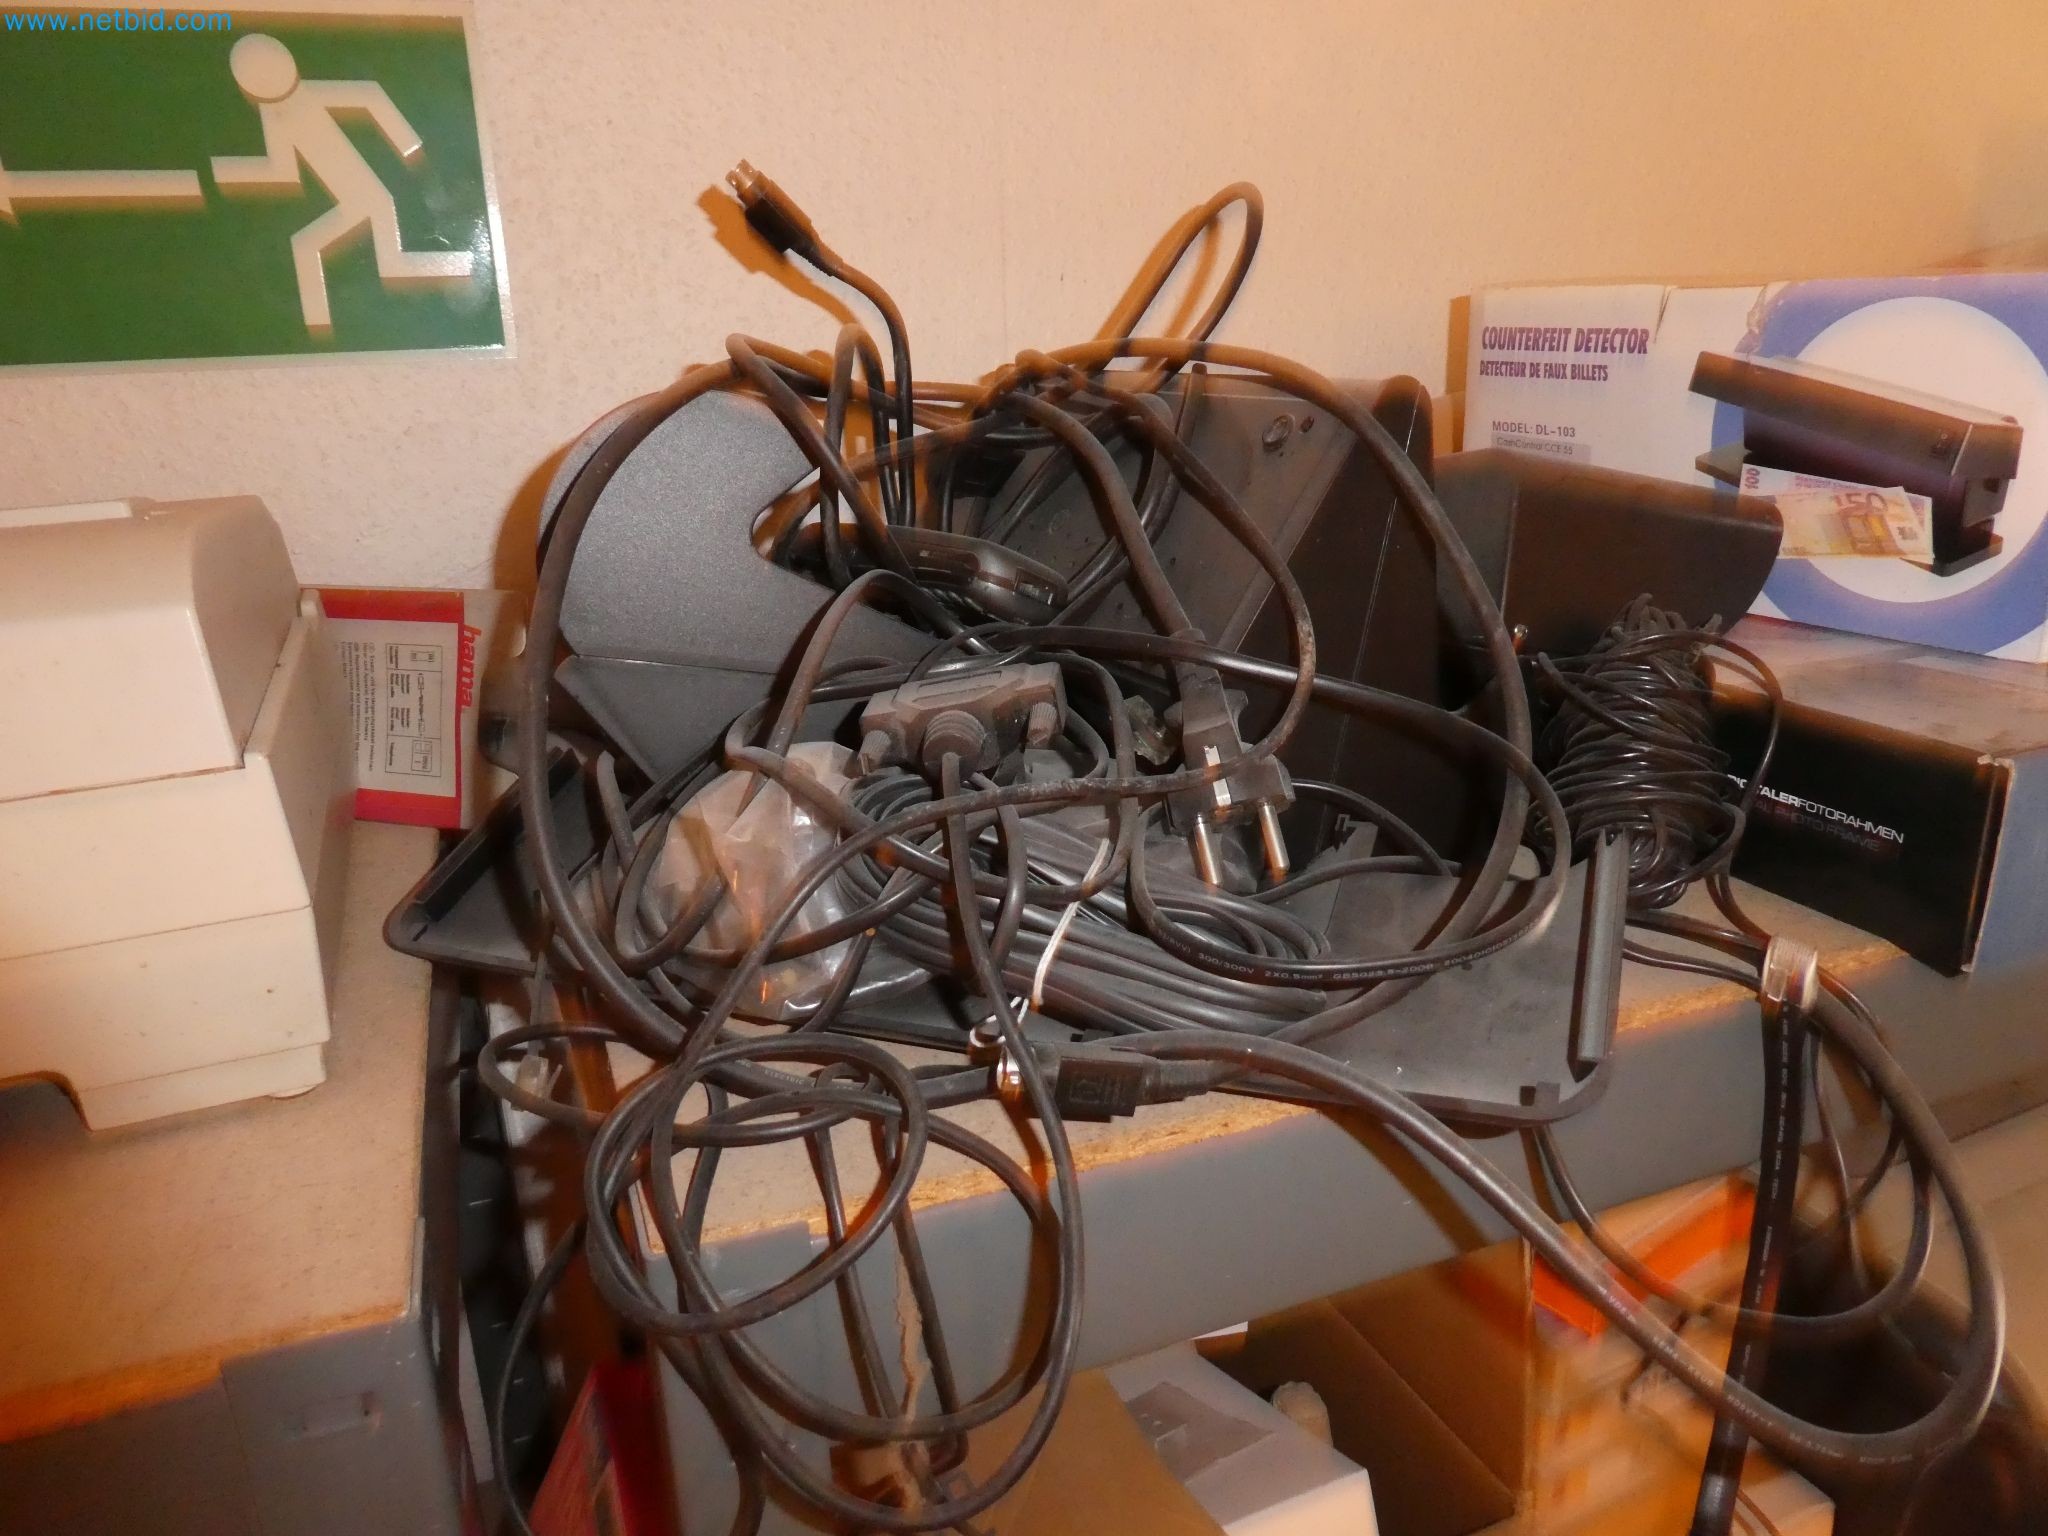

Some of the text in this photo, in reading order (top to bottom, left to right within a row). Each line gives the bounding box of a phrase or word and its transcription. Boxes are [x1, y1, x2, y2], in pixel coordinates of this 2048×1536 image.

[1482, 326, 1650, 354] COUNTERFEIT DETECTOR
[1479, 360, 1609, 381] DETECTEUR DE FAUX BILLETS
[1492, 420, 1576, 438] MODEL: DL-103
[461, 624, 482, 707] hama
